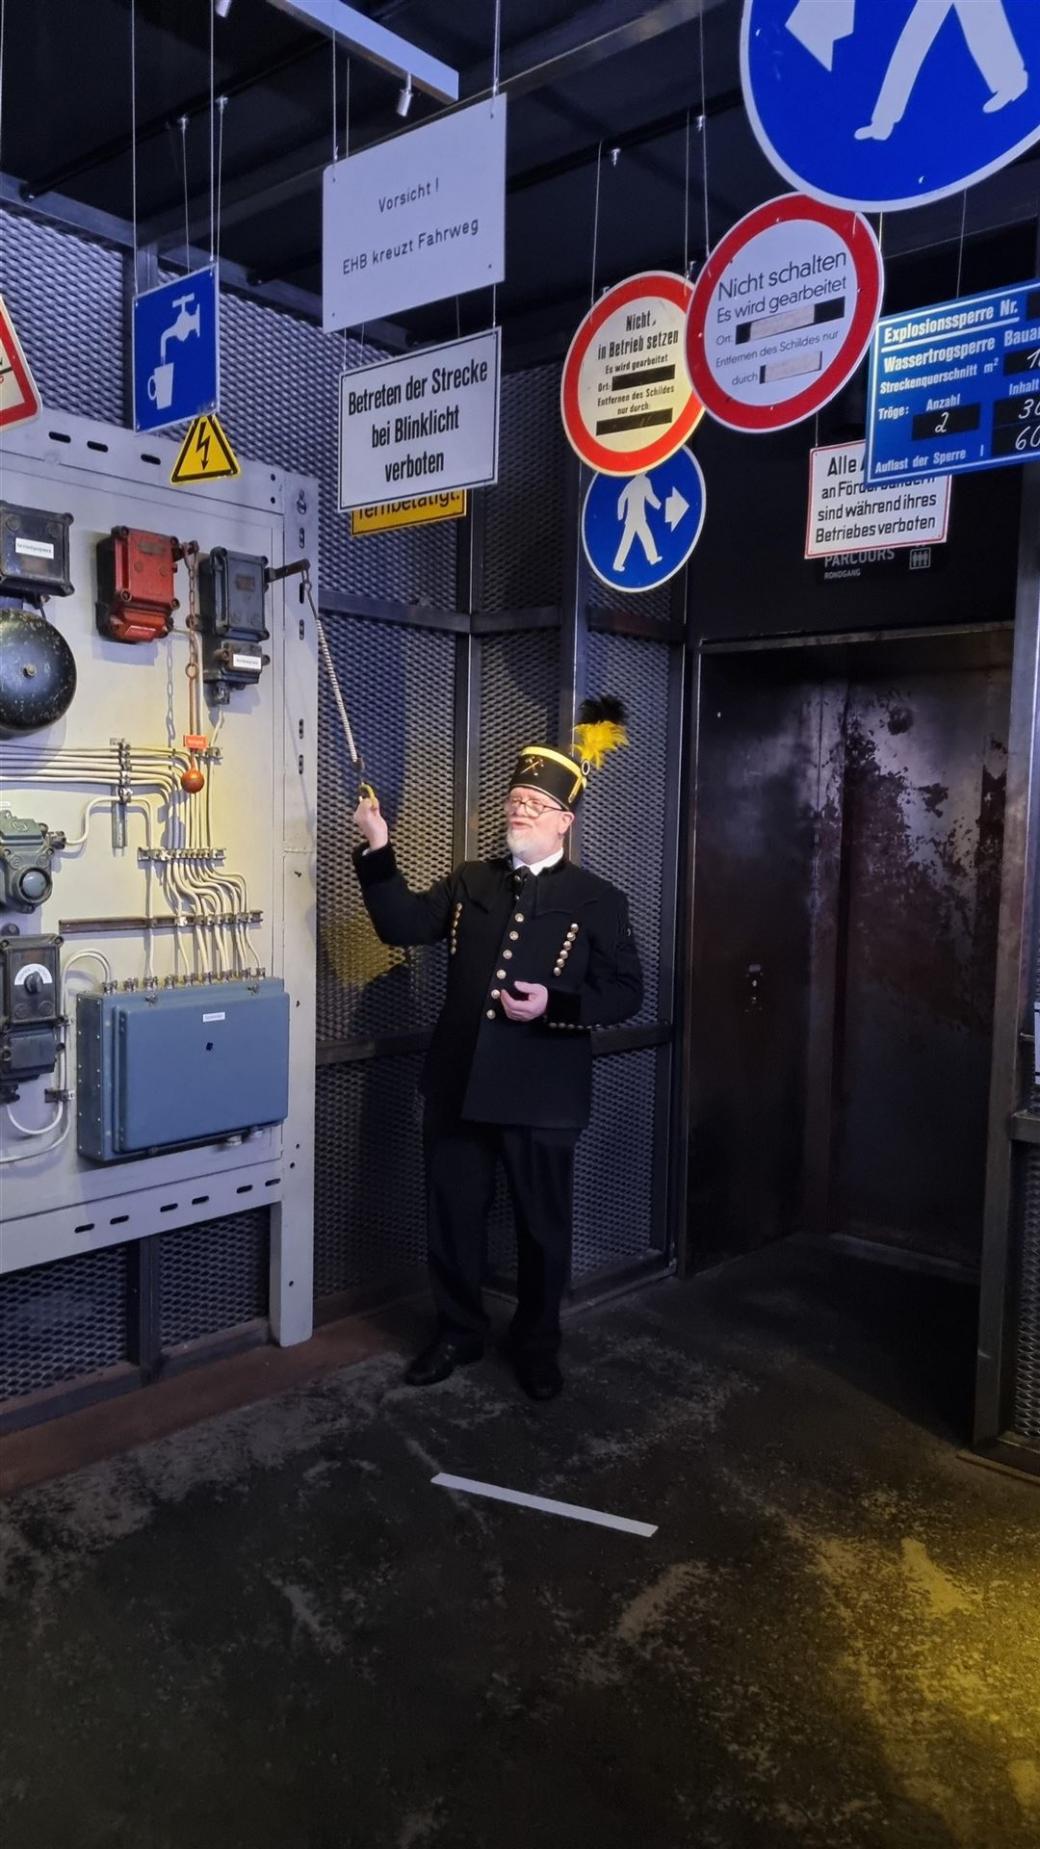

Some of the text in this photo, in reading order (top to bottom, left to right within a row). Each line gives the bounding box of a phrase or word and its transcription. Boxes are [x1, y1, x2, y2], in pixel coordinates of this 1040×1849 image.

[378, 182, 431, 212] Vorsicht
[343, 219, 479, 275] EHB kreuzt Fahrweg
[718, 251, 847, 301] Nicht schalten
[717, 276, 847, 324] Es wird gearbeitet
[626, 310, 651, 332] Nicht
[883, 299, 1018, 345] Explosionssperre Nr.
[598, 330, 679, 360] in Betrieb setzen
[715, 331, 839, 368] Entfernen des Schildes nur
[883, 337, 996, 374] Wassertrogsperre
[605, 353, 668, 375] Es wird gearbeitet
[348, 359, 488, 416] Betreten der Strecke
[732, 370, 758, 386] durch
[880, 364, 978, 395] Streckenquerschnitt
[1008, 379, 1040, 396] Inhalt
[597, 385, 675, 407] Entfernen des Schildes
[617, 401, 649, 415] nur durch
[926, 393, 961, 412] Anzahl
[372, 405, 460, 448] bei Blinklicht
[878, 406, 910, 420] Tröge:
[934, 411, 949, 433] 2
[385, 451, 444, 482] verboten
[827, 455, 857, 477] Alle
[875, 457, 908, 474] Auflast
[912, 455, 929, 468] der
[932, 449, 967, 465] Sperre
[822, 487, 836, 500] an
[818, 494, 937, 521] sind während ihres
[815, 516, 936, 543] Betriebes verboten
